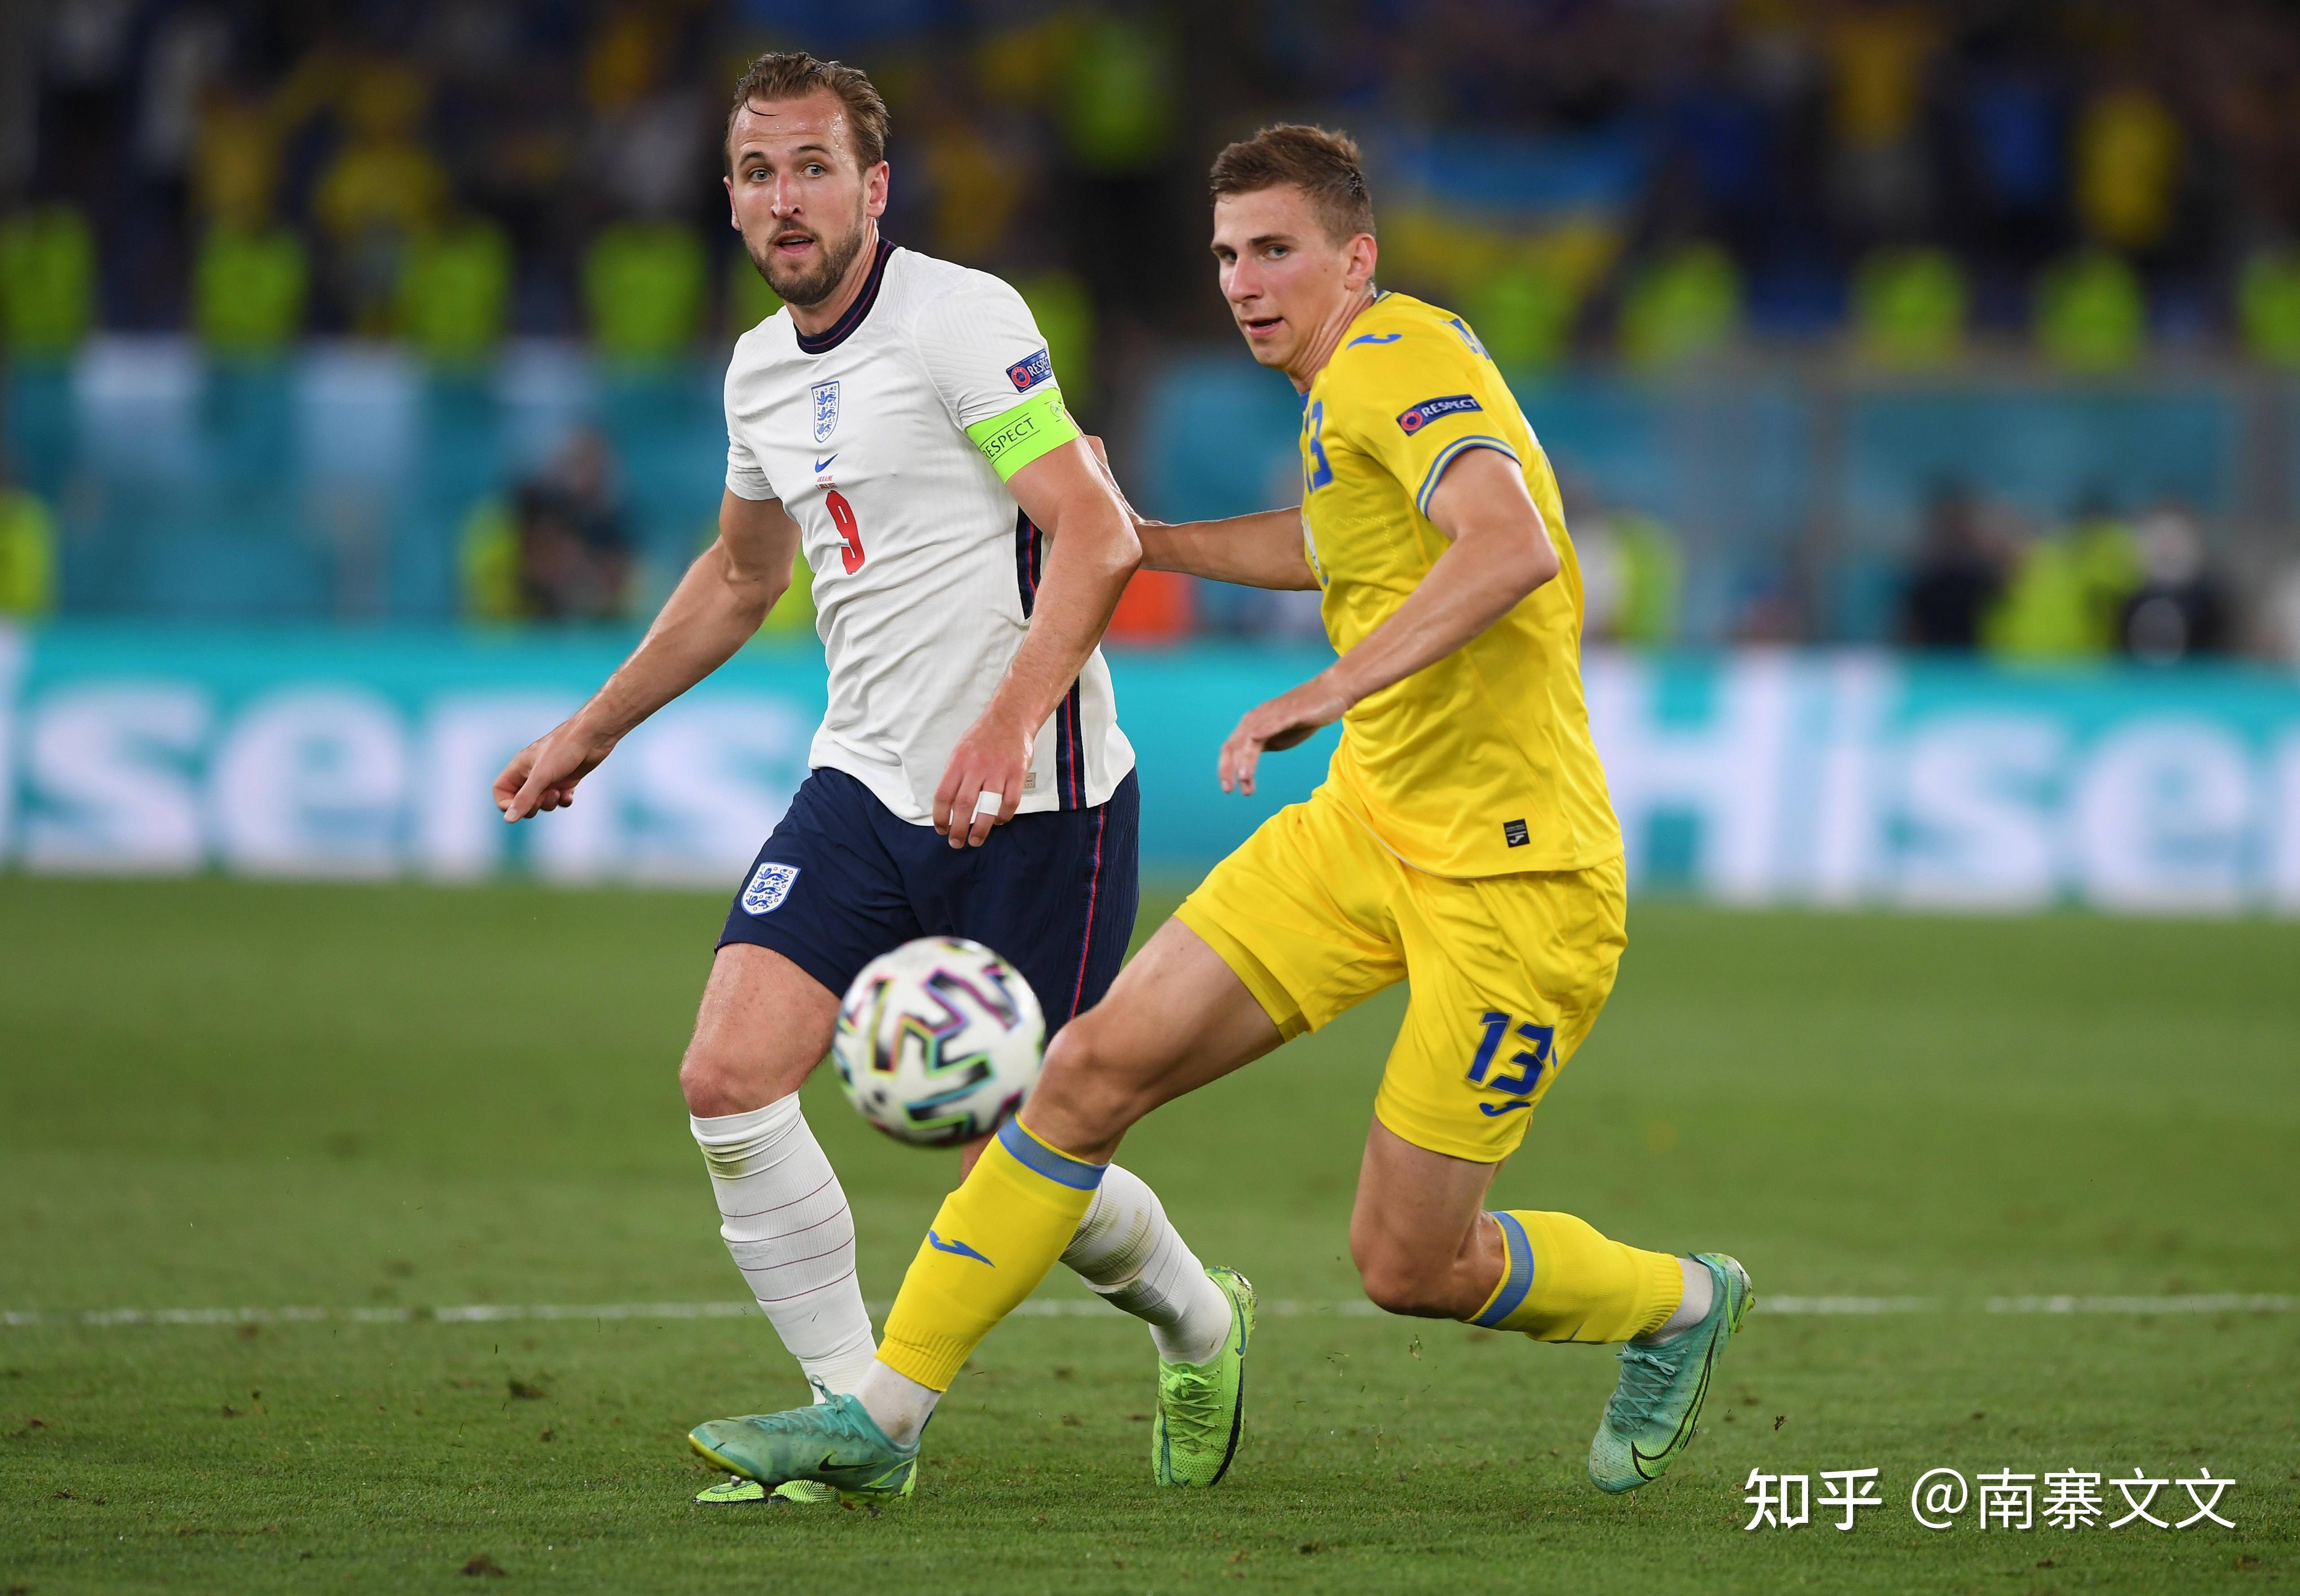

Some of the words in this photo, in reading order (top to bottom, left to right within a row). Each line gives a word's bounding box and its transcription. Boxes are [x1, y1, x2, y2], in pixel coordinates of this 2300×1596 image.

[1421, 399, 1477, 417] RESPECT
[825, 490, 865, 574] 9
[1465, 1011, 1555, 1096] 13
